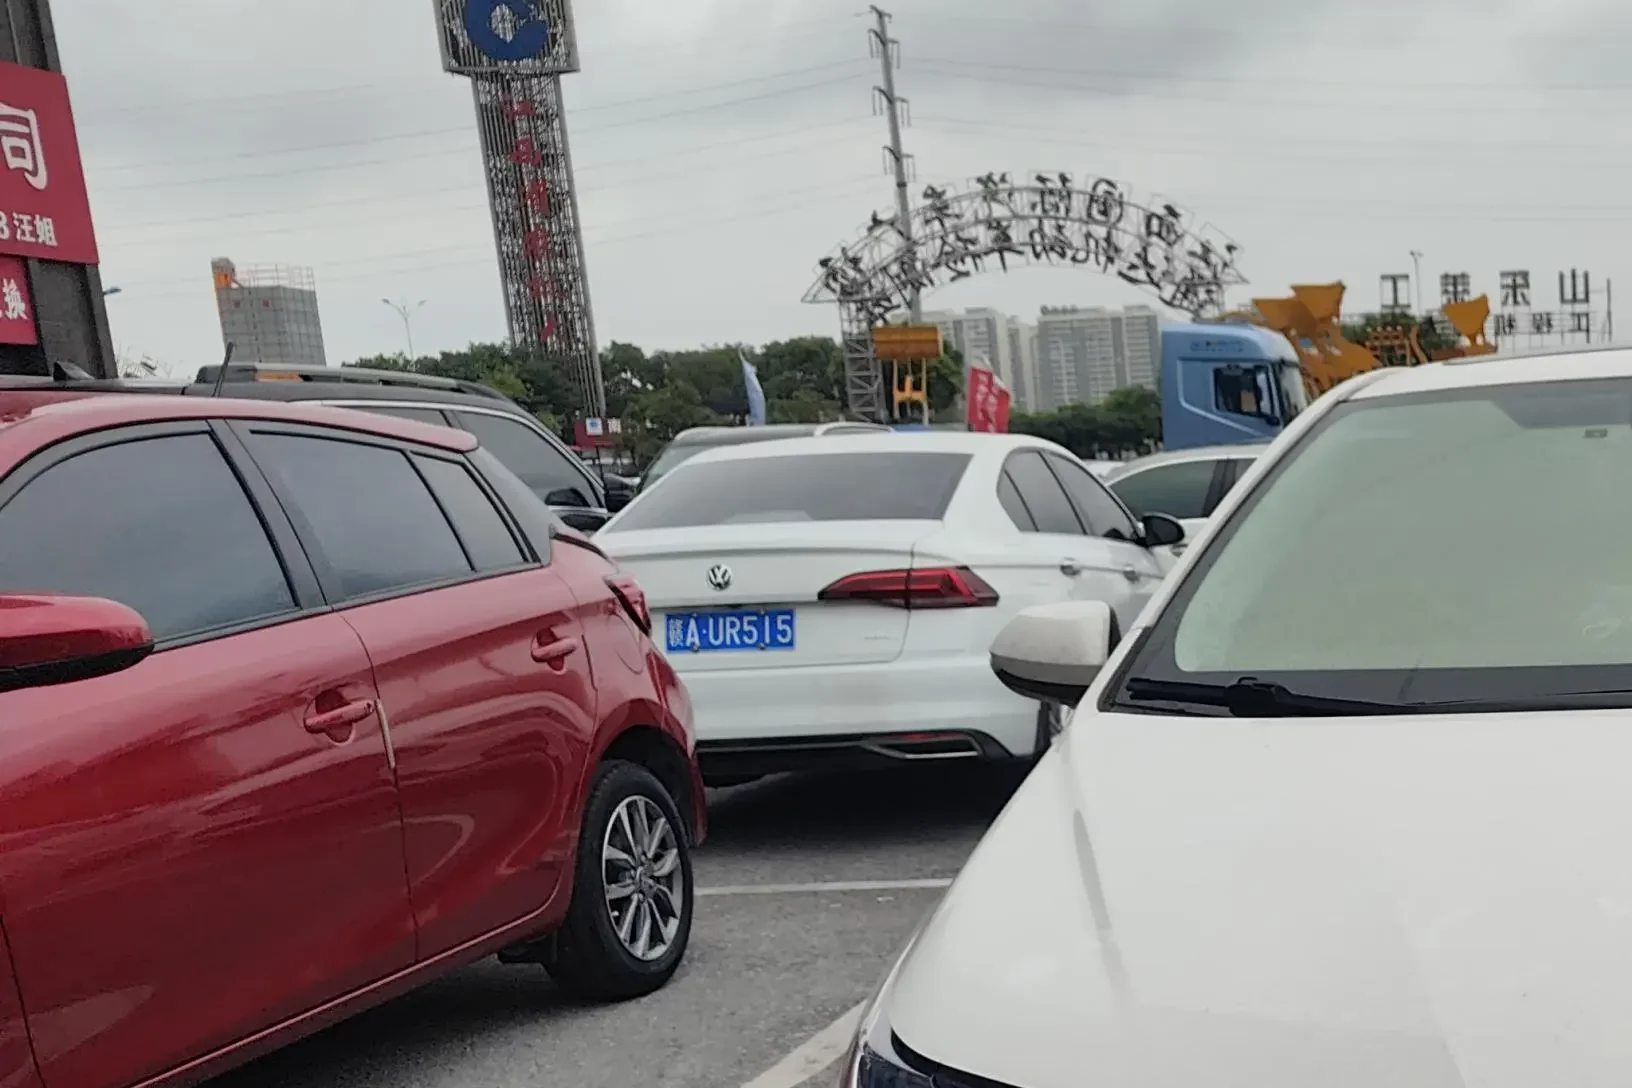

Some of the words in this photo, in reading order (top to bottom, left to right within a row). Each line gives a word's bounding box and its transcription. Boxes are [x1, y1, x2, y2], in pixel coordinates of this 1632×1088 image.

[0, 102, 47, 189] 司
[12, 212, 58, 246] 汪姐
[0, 278, 28, 320] 换
